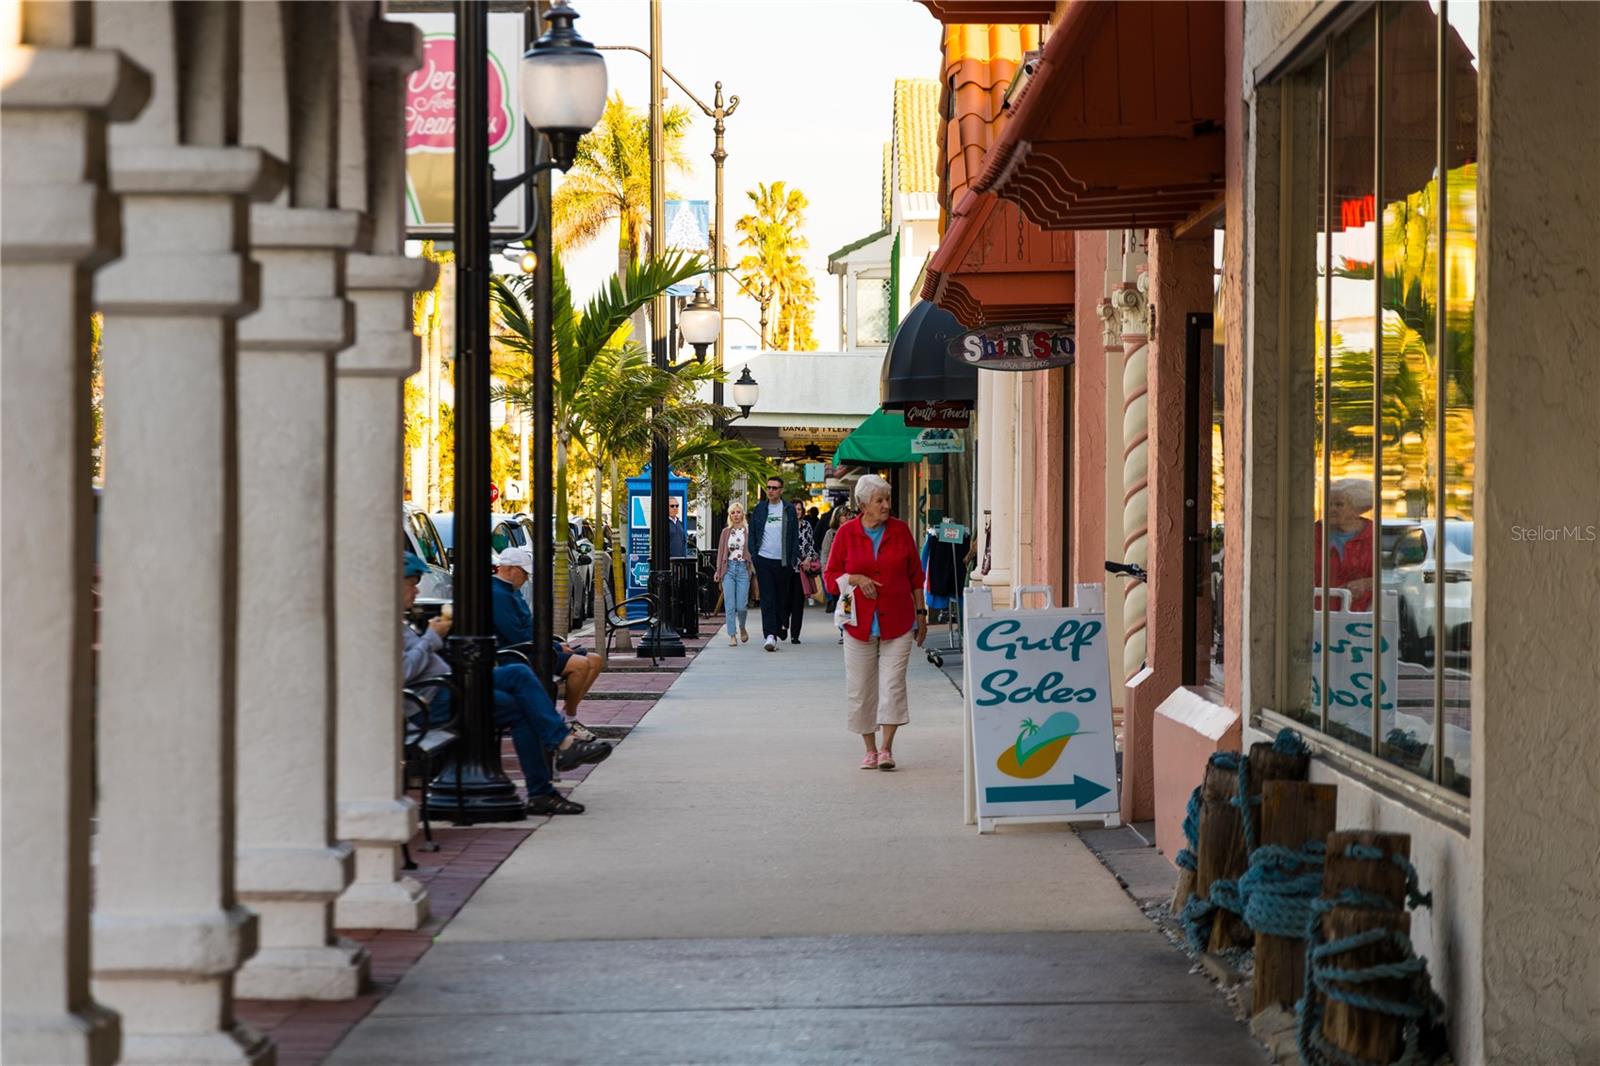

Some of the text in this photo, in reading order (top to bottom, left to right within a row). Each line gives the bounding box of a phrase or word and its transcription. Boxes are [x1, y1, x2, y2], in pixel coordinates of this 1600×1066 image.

[1033, 331, 1075, 359] Sto
[976, 619, 1103, 662] Gulf
[976, 669, 1097, 707] Soles
